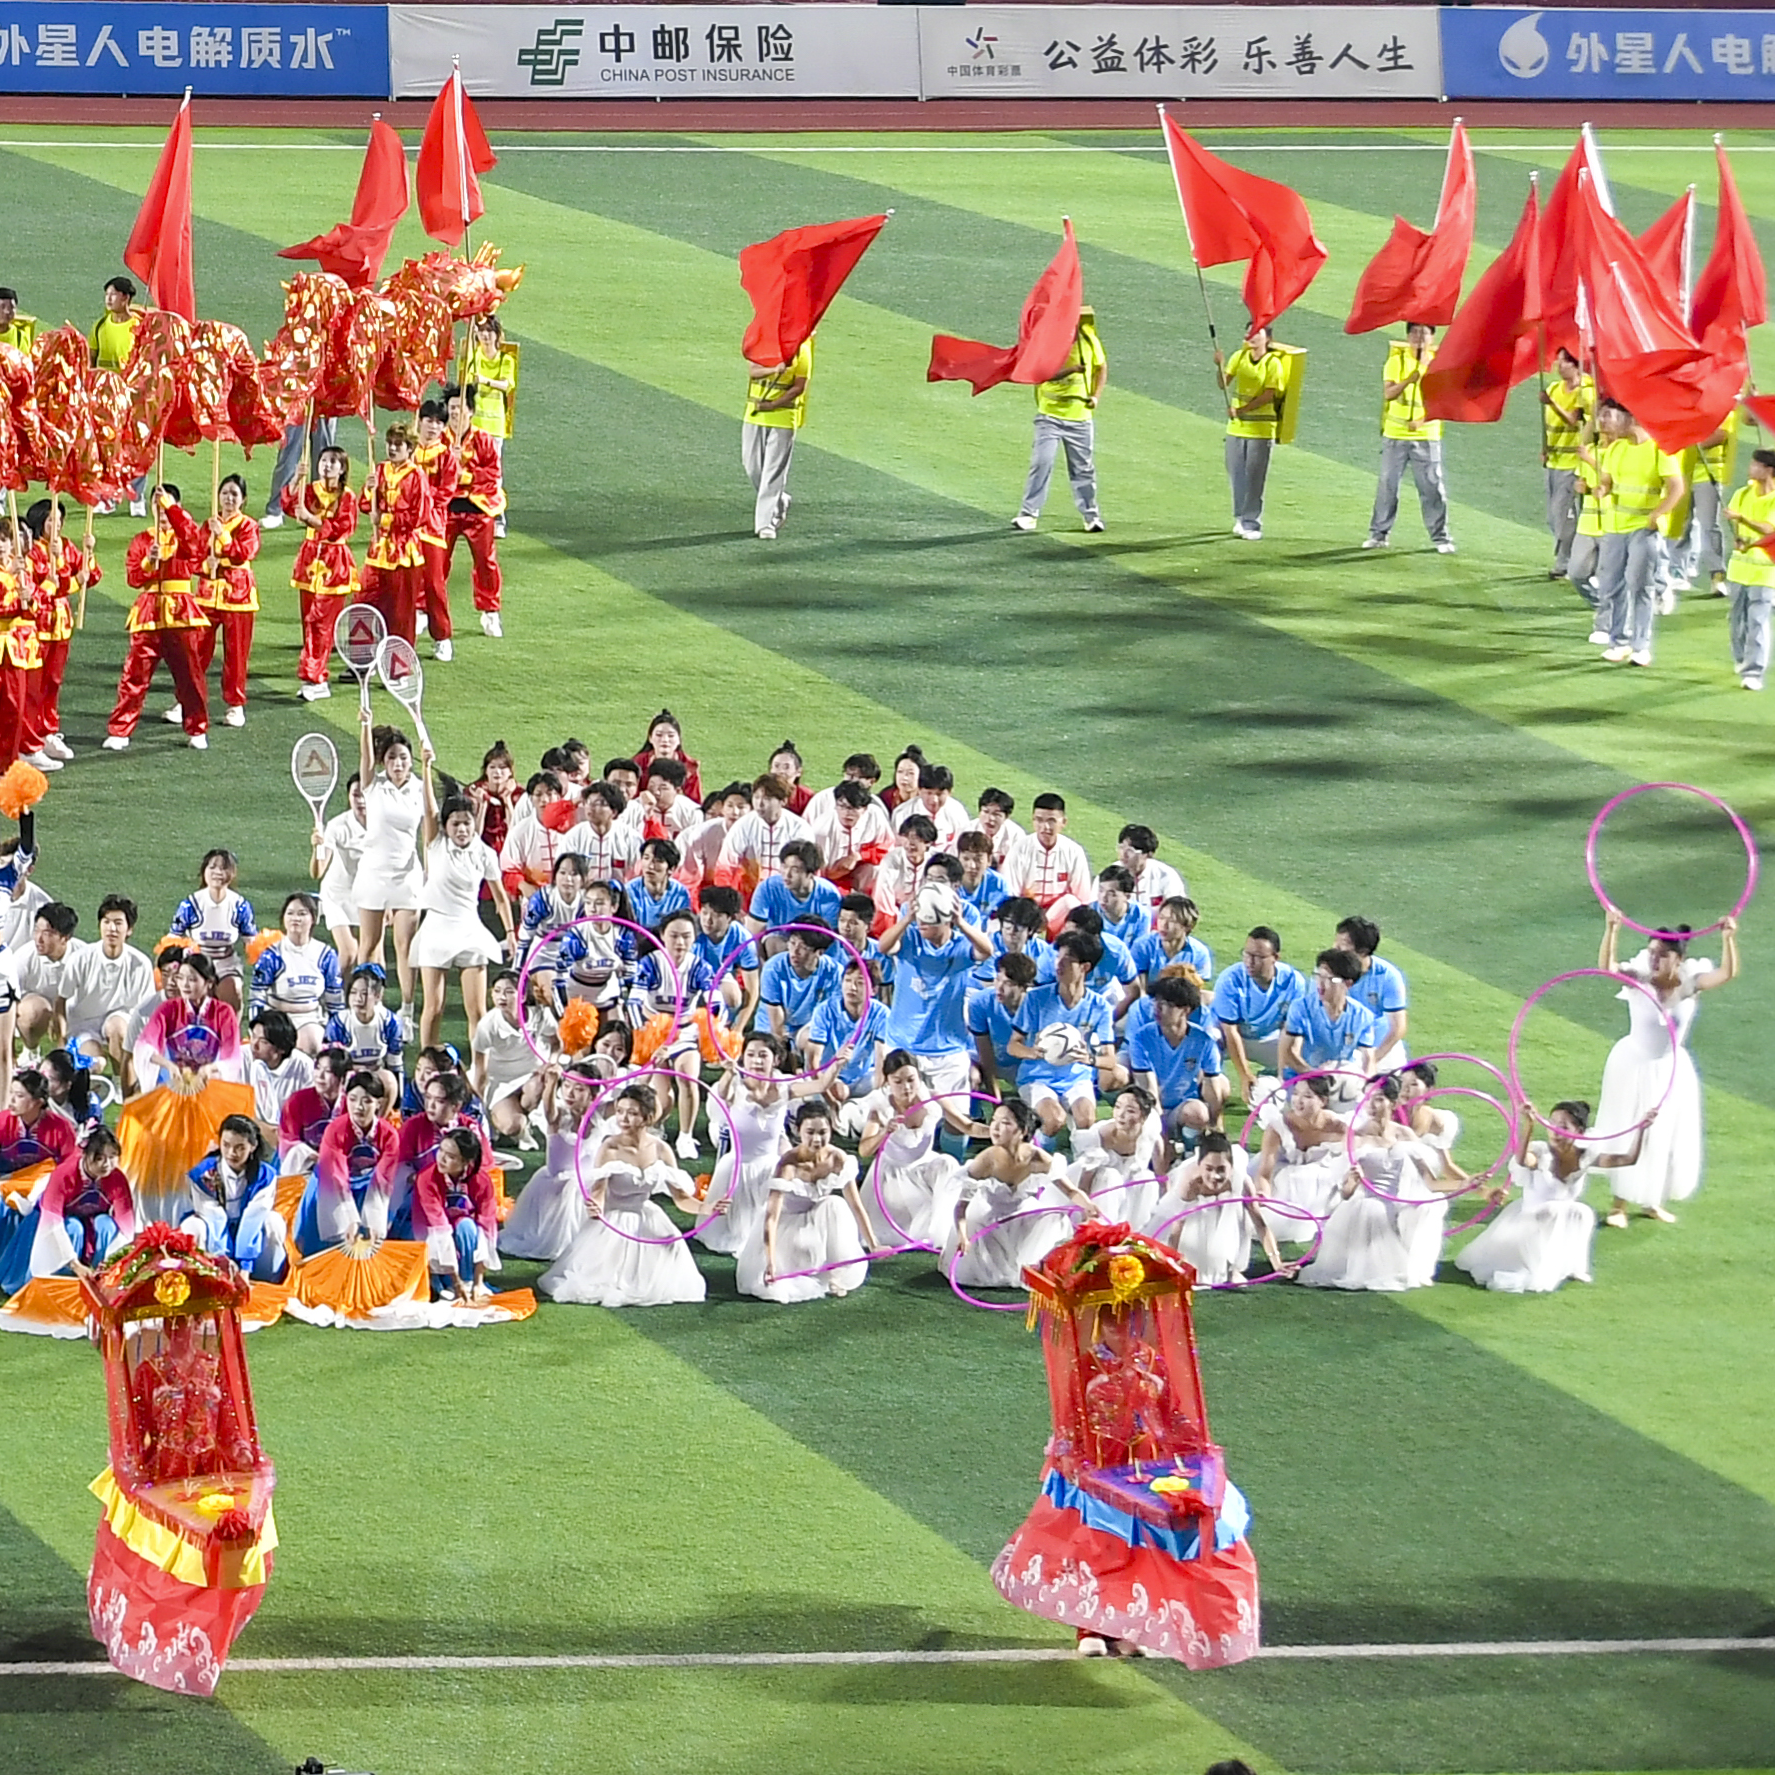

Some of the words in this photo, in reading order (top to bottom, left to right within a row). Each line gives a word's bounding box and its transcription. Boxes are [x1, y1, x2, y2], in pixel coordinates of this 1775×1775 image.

[598, 23, 794, 65] 中邮保险
[1042, 34, 1219, 76] 公益体彩
[1241, 34, 1416, 75] 乐善人生
[600, 67, 651, 82] CHINA
[655, 67, 698, 82] POST
[701, 67, 795, 82] INSURANCE
[947, 64, 1023, 77] 中国体育彩票
